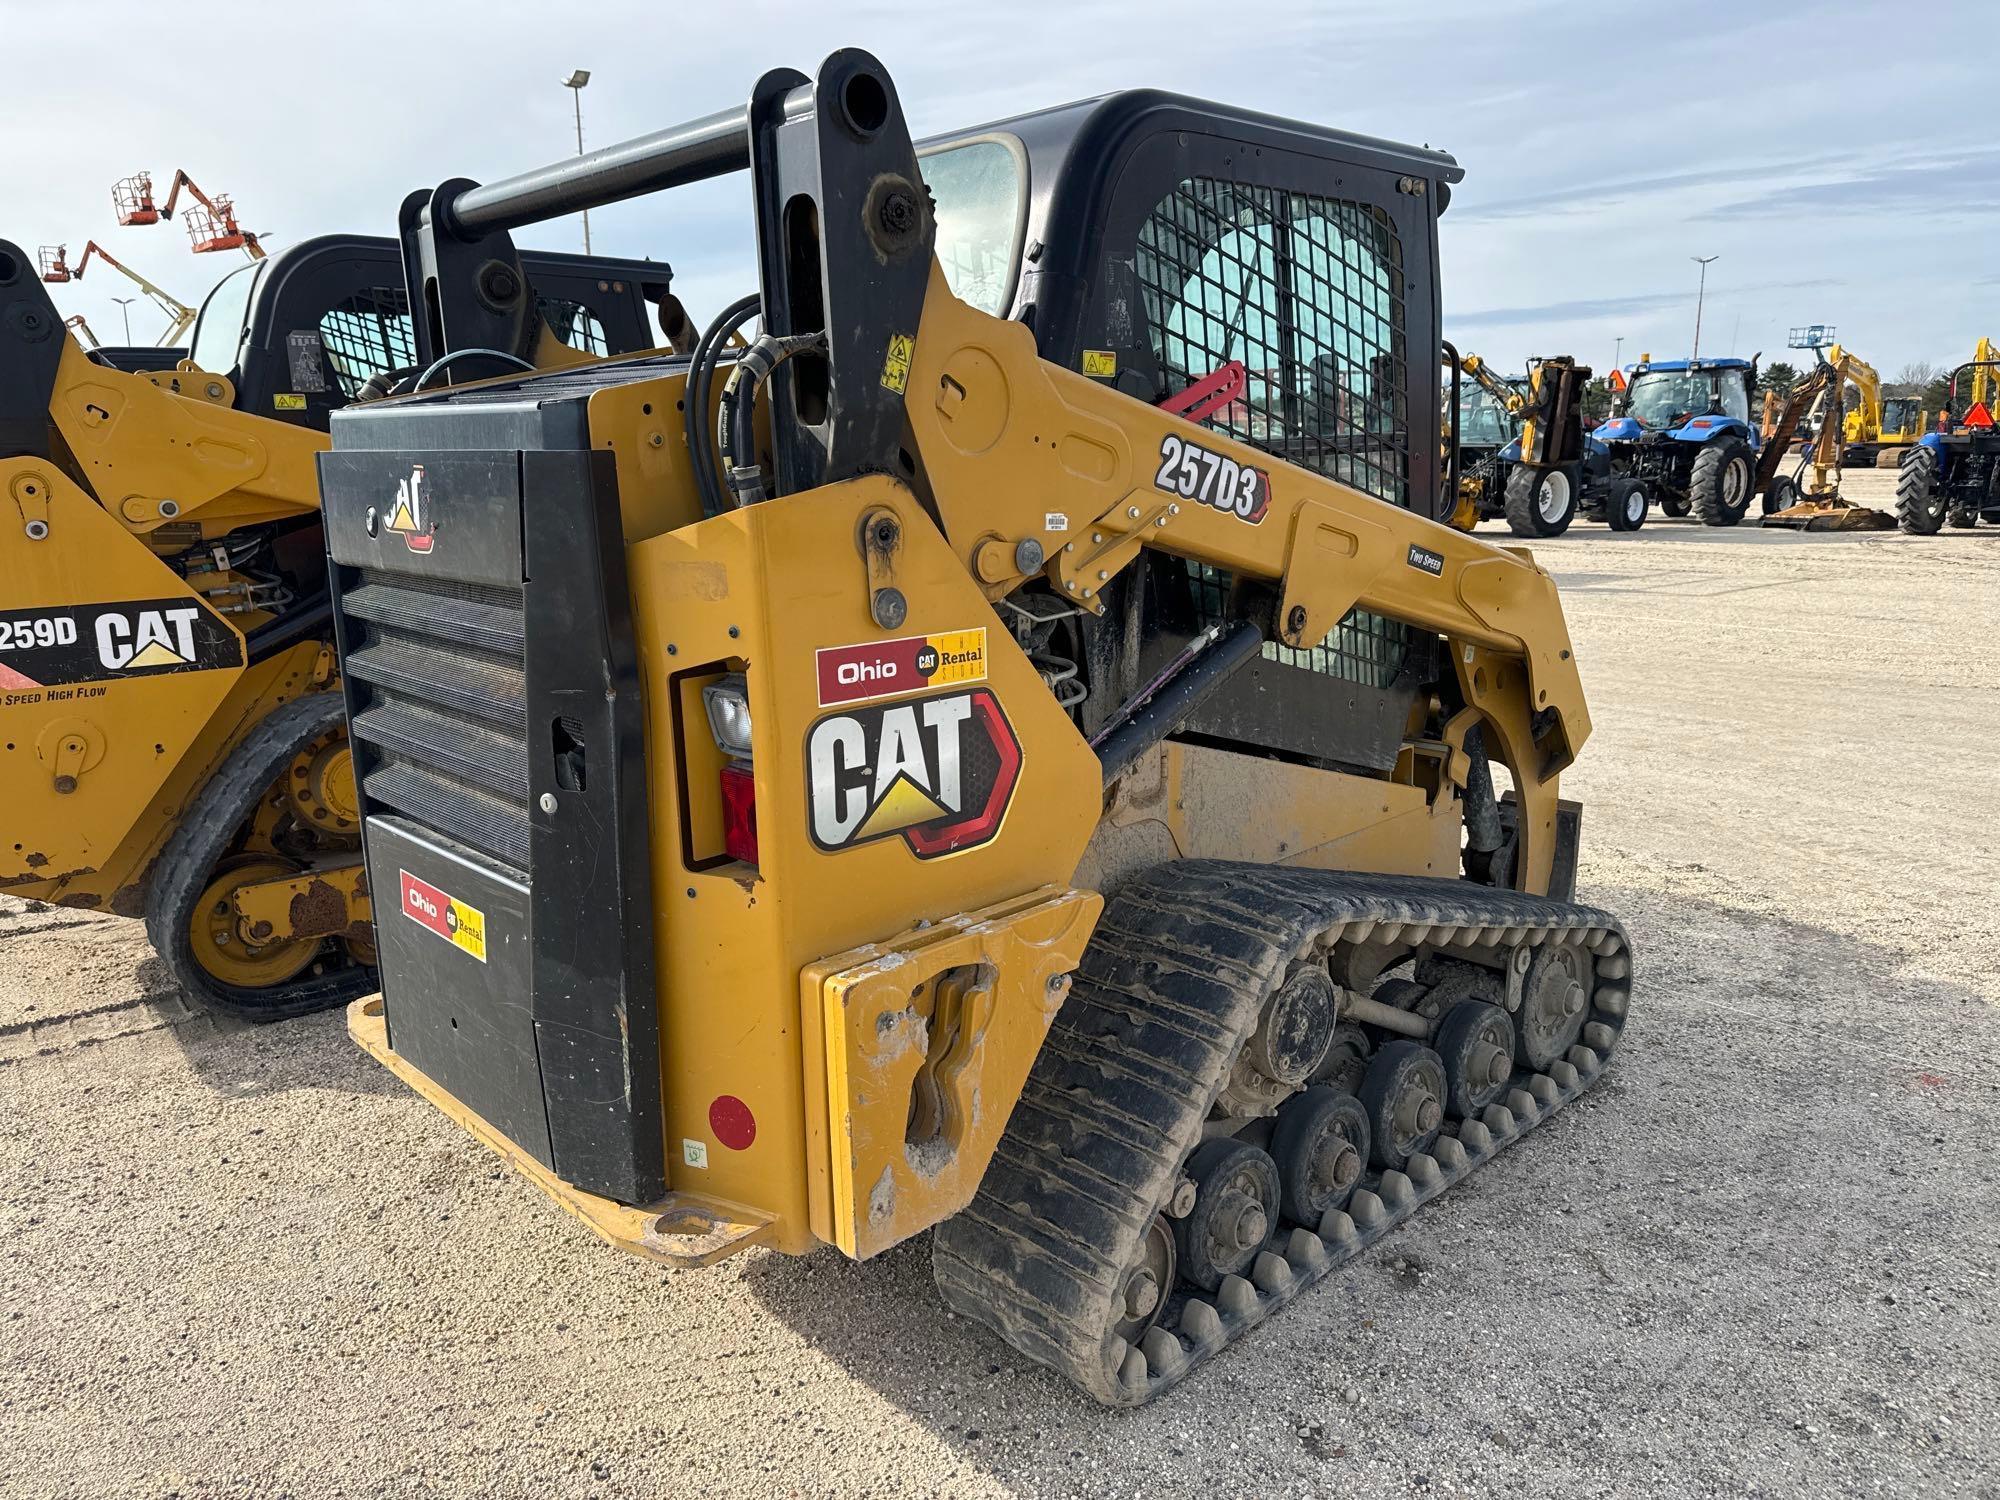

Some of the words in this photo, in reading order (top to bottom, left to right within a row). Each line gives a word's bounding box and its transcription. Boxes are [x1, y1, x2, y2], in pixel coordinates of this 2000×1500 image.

[1156, 436, 1257, 516] 257D3
[0, 617, 78, 650] 259D
[95, 607, 199, 670] CAT
[837, 659, 897, 685] Ohio
[918, 654, 935, 669] CAT
[941, 647, 983, 666] Rental
[5, 694, 41, 706] SPEED
[47, 690, 73, 701] HIGH
[77, 687, 107, 698] FLOW
[810, 694, 972, 845] CAT
[409, 888, 438, 918] Ohio
[459, 918, 483, 942] Rental
